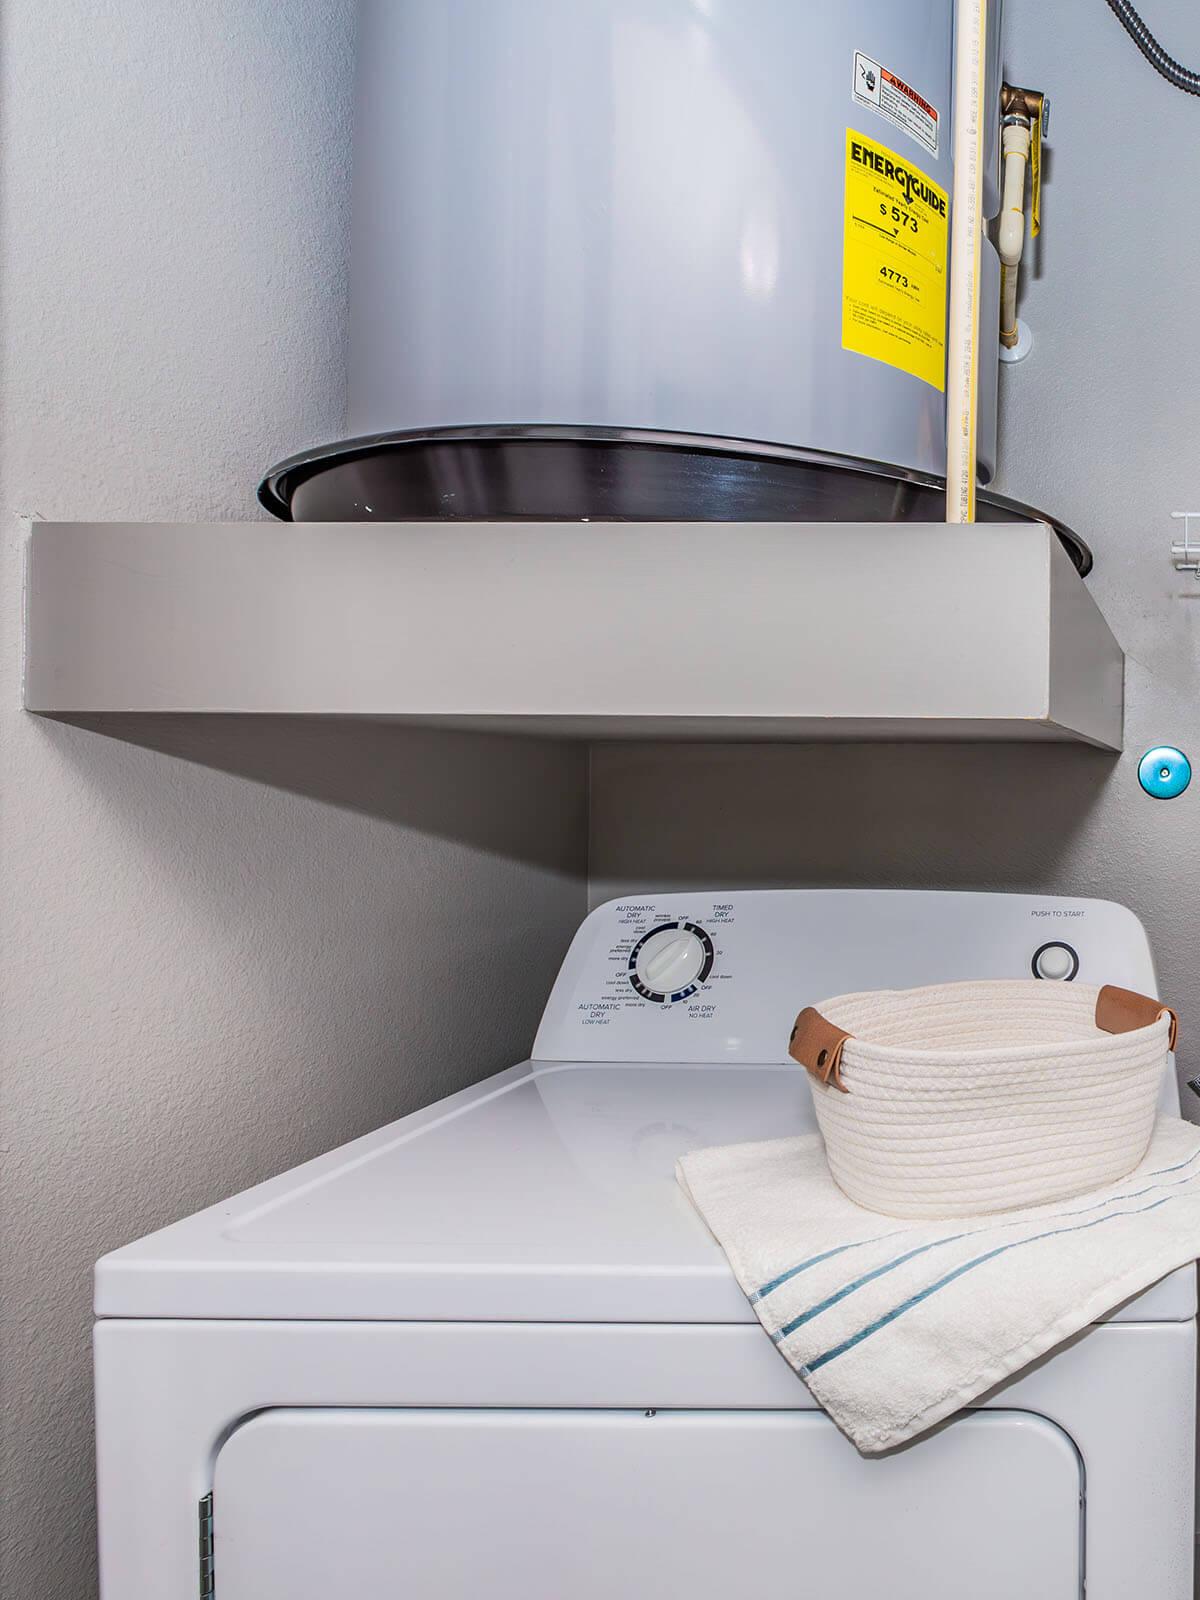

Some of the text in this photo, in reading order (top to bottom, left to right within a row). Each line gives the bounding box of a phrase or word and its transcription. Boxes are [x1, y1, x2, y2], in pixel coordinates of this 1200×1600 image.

[880, 203, 918, 233] $ 573
[880, 267, 908, 287] 4773
[960, 487, 968, 507] TUBING
